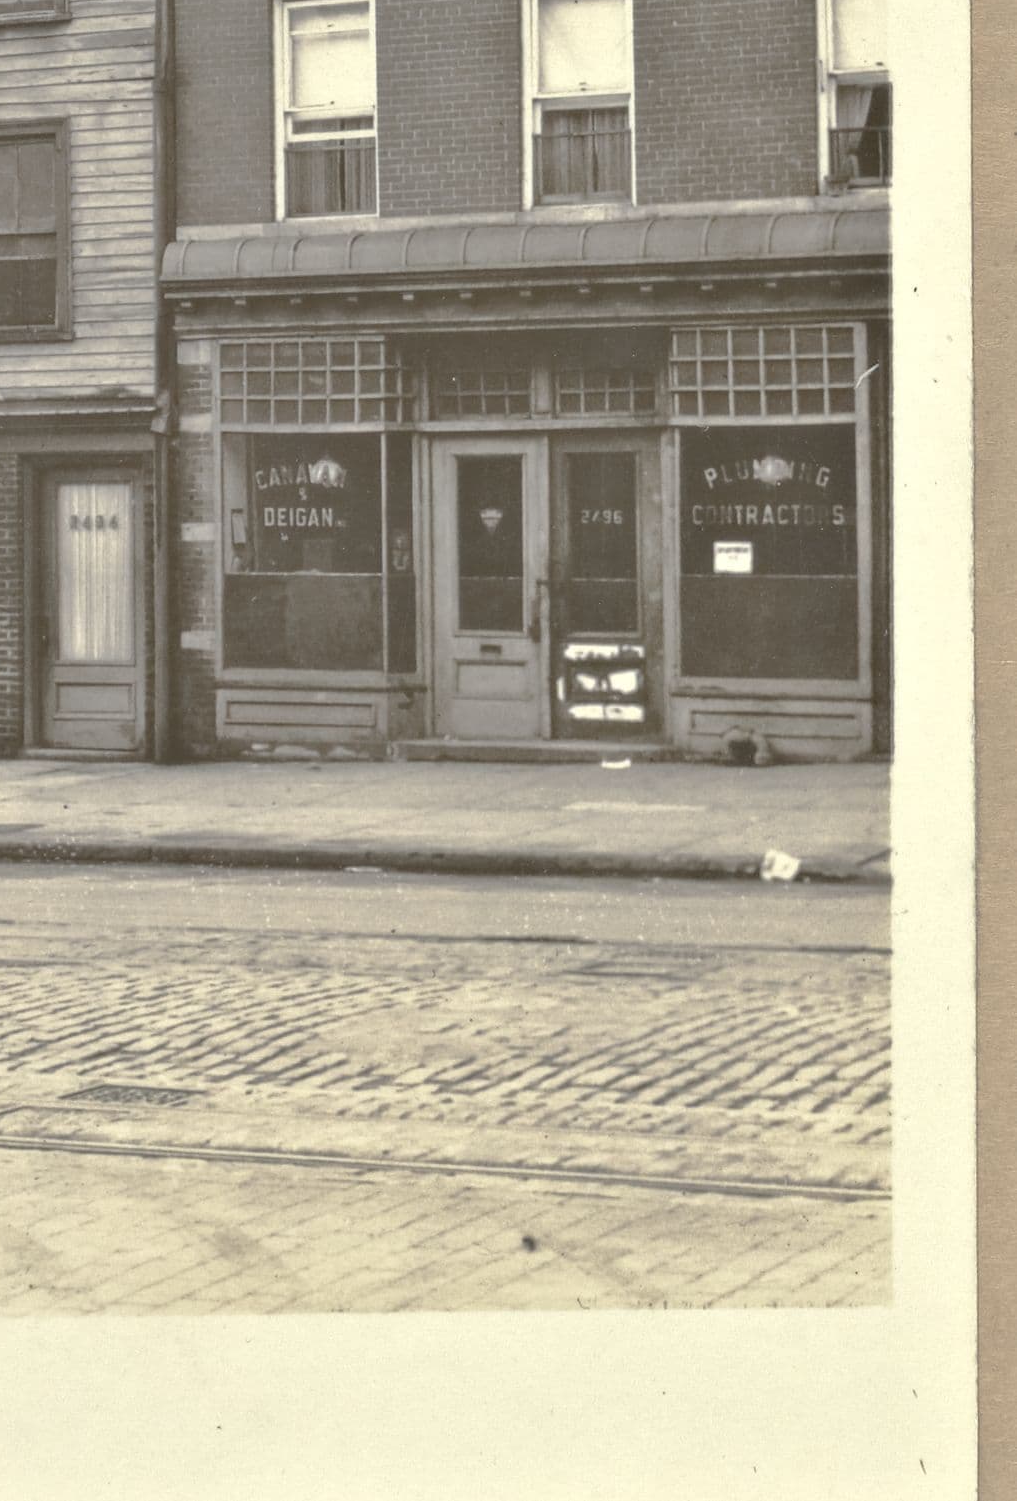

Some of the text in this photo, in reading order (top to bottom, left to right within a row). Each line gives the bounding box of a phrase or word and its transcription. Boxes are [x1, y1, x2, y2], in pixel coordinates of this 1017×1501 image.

[263, 507, 333, 527] DEIGAN
[581, 509, 623, 525] 2496
[692, 504, 845, 526] CONTRACTORS
